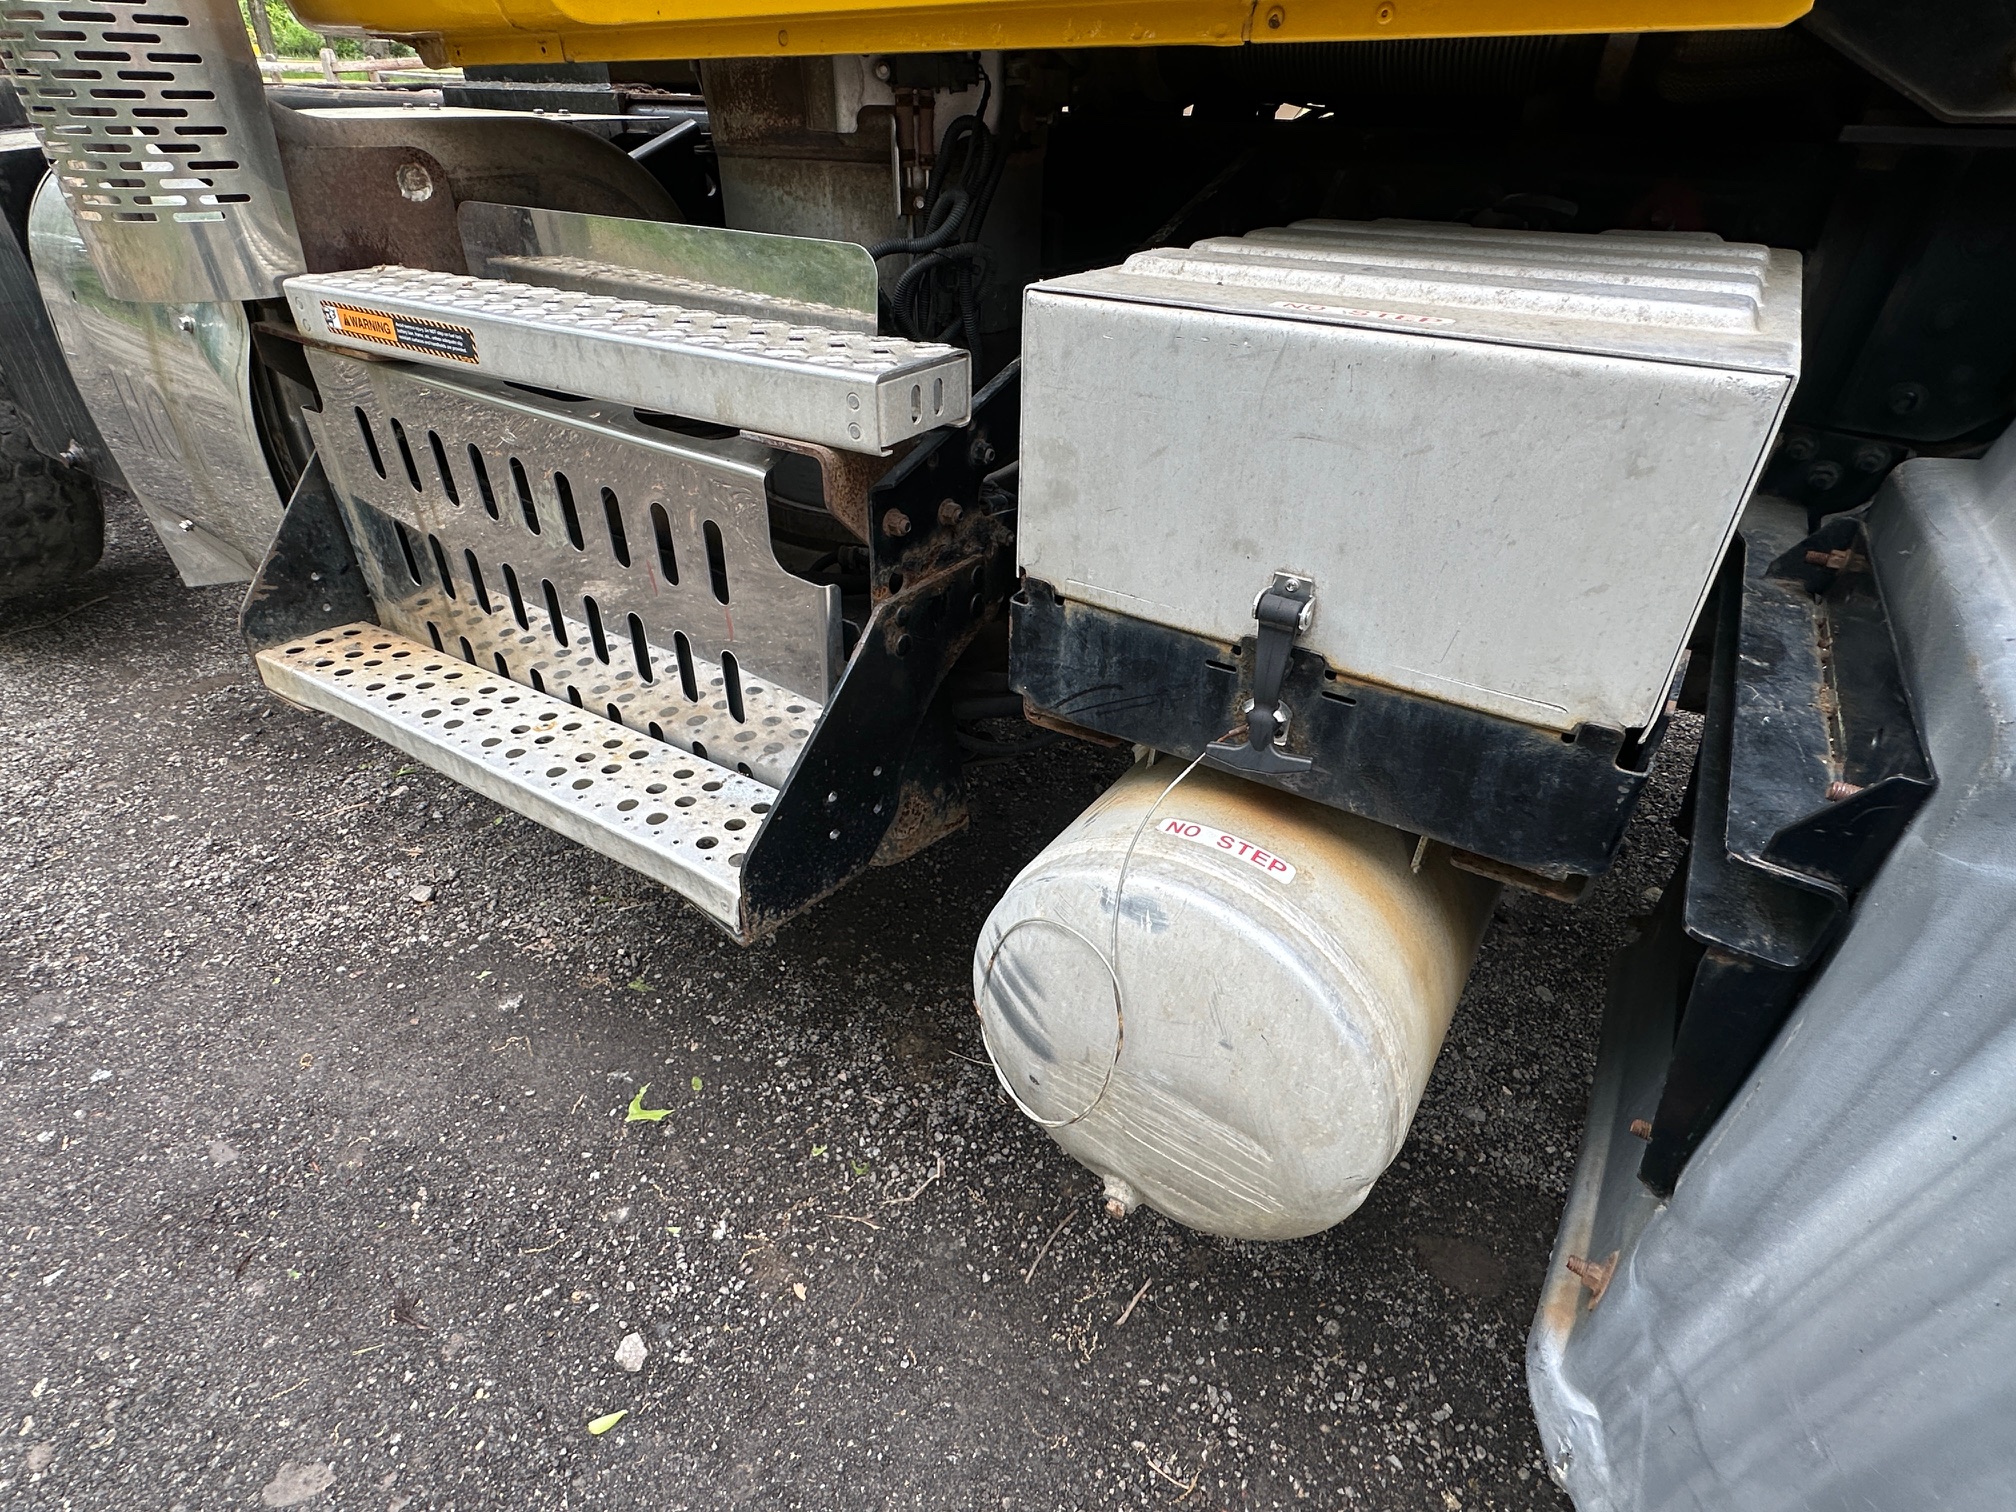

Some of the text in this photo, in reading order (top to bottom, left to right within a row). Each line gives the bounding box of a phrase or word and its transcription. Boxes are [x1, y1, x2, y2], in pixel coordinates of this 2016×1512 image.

[1283, 302, 1442, 323] NO STEP
[349, 315, 391, 334] WARNING
[1165, 821, 1287, 872] NO STEP
